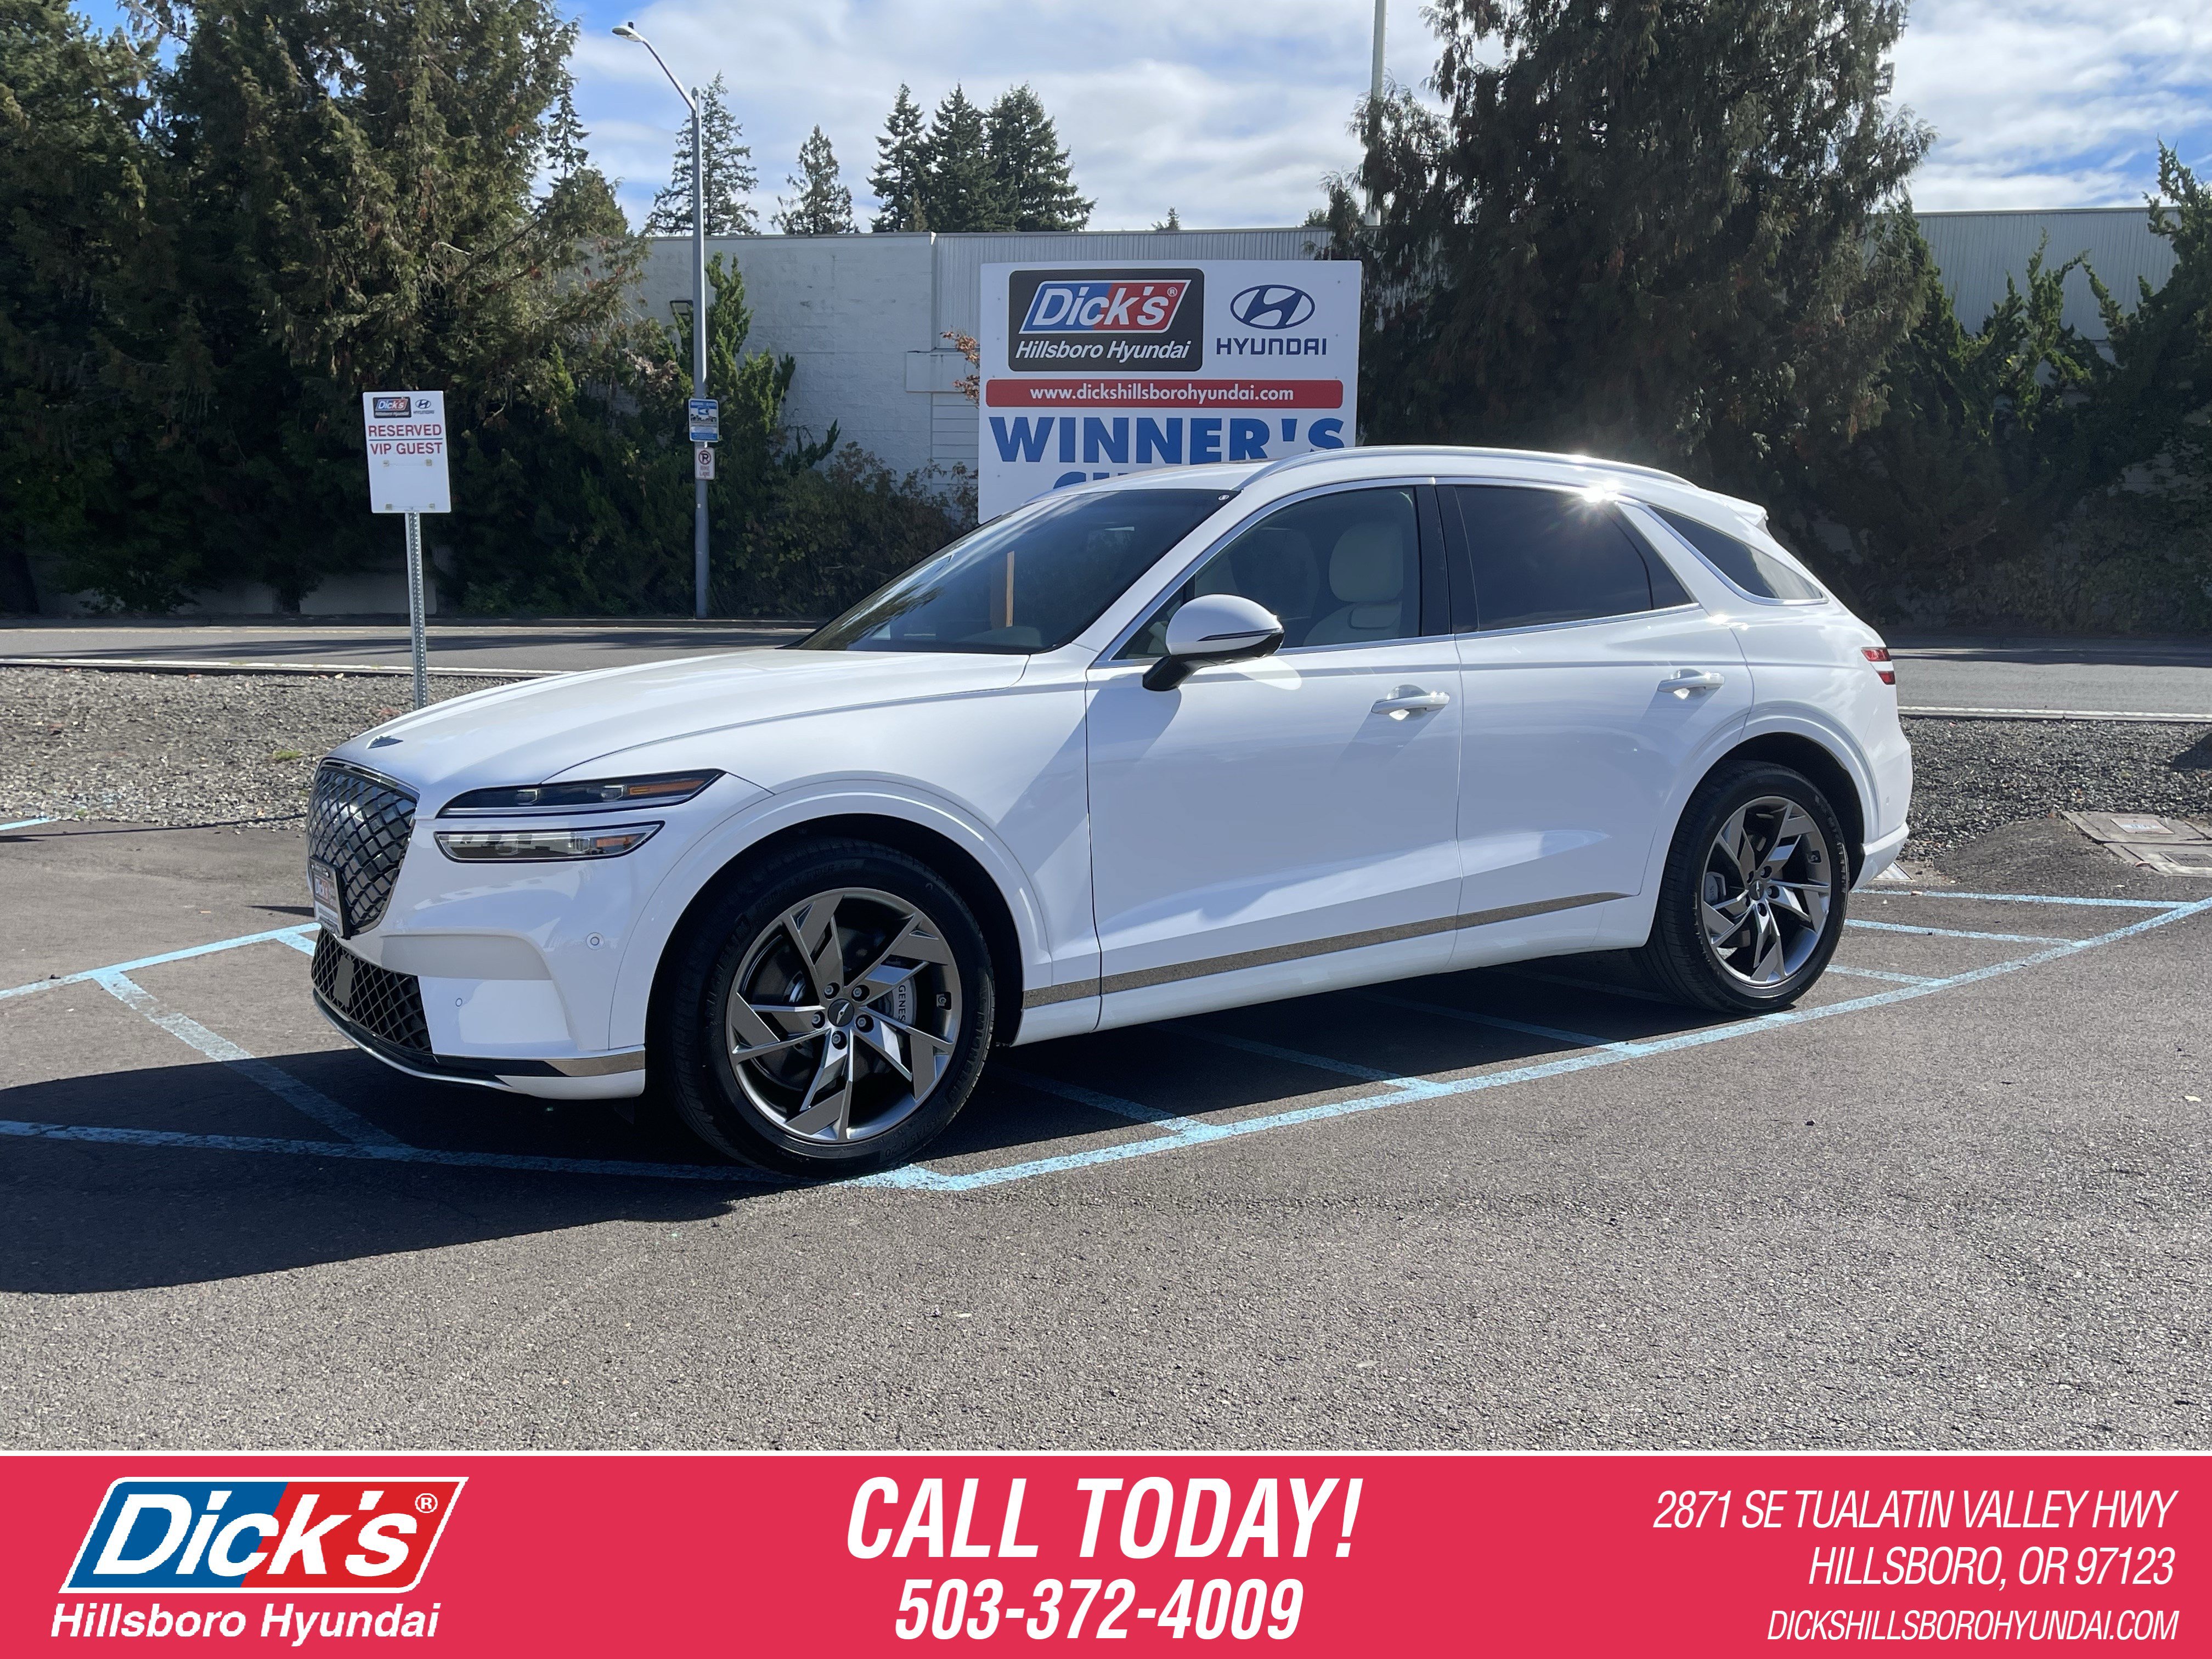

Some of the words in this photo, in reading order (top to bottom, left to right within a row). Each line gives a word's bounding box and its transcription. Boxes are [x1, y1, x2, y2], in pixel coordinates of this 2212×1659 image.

[1032, 286, 1169, 326] Dick's
[1015, 340, 1103, 359] Hillsboro
[1107, 340, 1191, 363] Hyundai
[1216, 338, 1327, 356] HYUNDAI
[1030, 383, 1294, 403] www.dickshillsborohyundai.com
[368, 424, 442, 437] RESERVED
[370, 443, 391, 455] VIP
[396, 442, 443, 455] GUEST
[898, 984, 906, 1022] GENES
